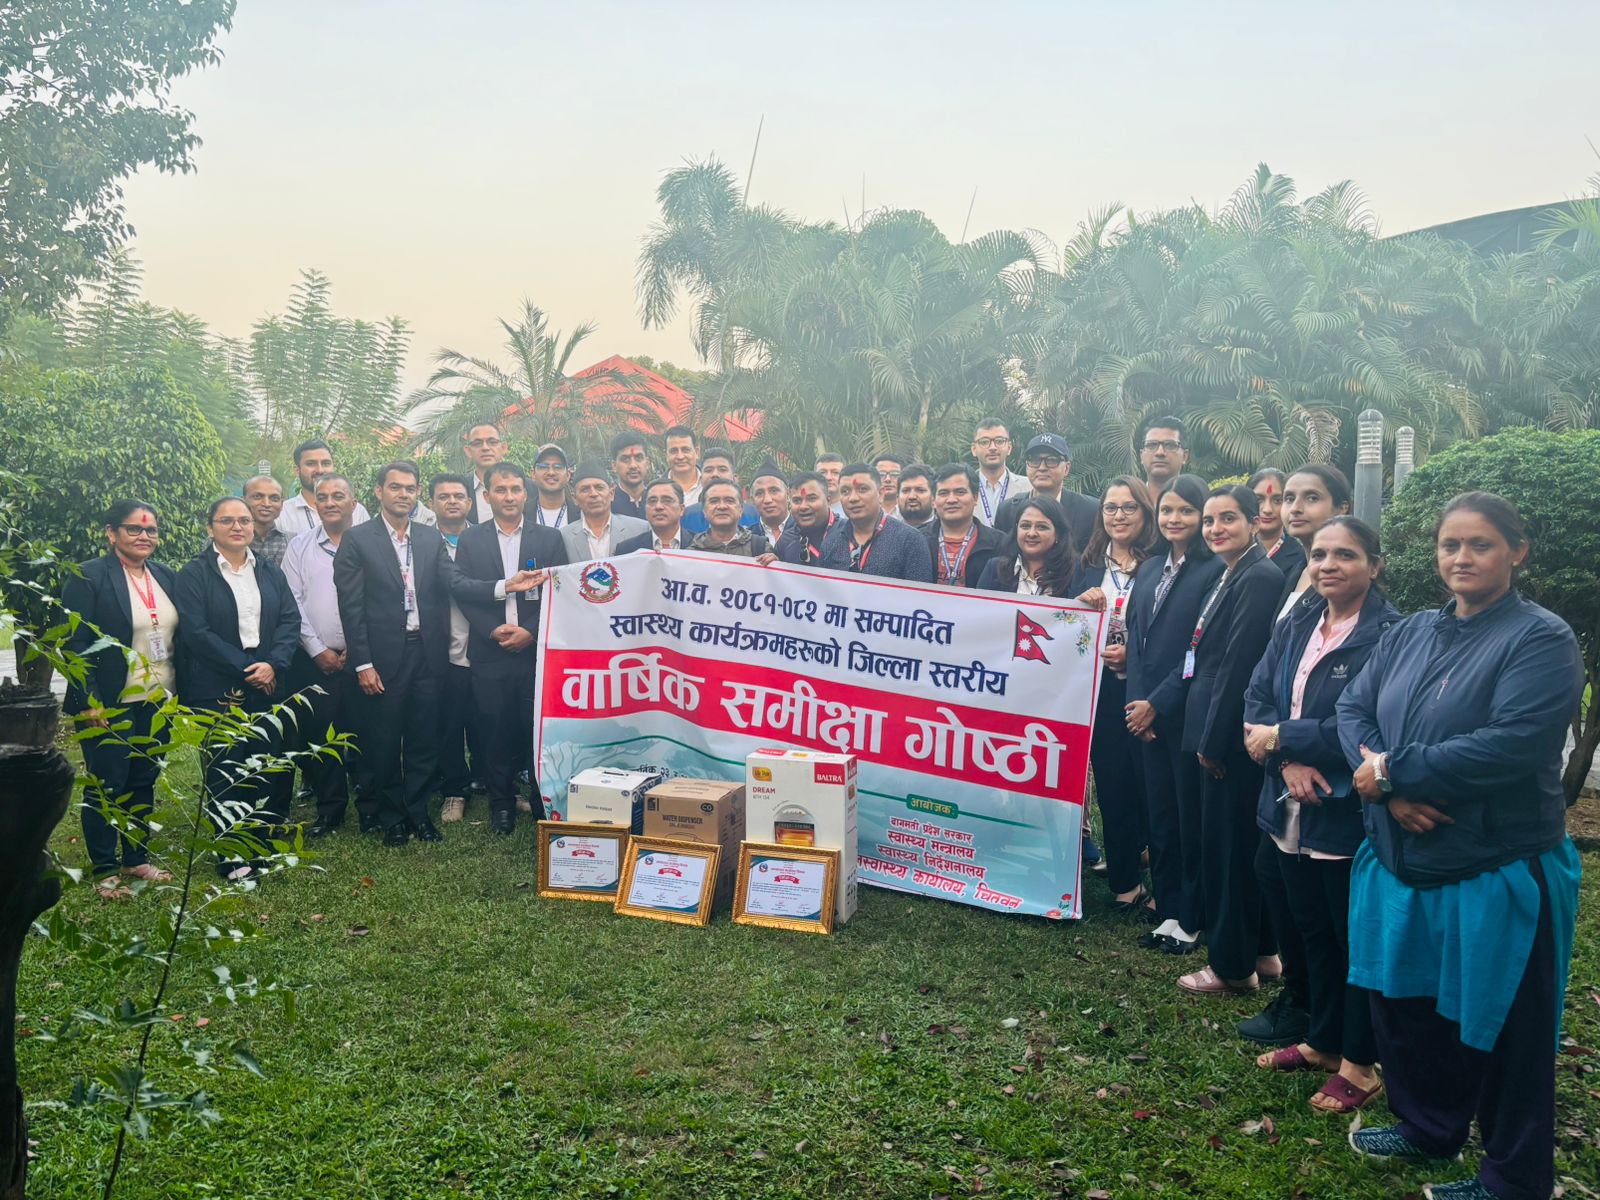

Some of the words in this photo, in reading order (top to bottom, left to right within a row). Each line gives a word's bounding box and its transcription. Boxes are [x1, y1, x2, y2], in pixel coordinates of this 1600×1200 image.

[661, 577, 711, 605] आ.व.
[720, 587, 818, 622] २०८१-०८२
[824, 603, 849, 628] मा
[854, 608, 955, 645] सम्पादित
[609, 613, 683, 639] स्वास्थ्य
[848, 640, 922, 681] जिल्ला
[929, 660, 1009, 696] स्तरीय
[562, 652, 705, 711] वार्षिक
[720, 679, 888, 754] समीक्षा
[904, 706, 1067, 789] गोष्ठी
[752, 786, 776, 794] DREAM
[816, 773, 842, 783] BALTRA
[887, 830, 926, 849] स्वास्थ्य
[930, 840, 975, 860] मन्त्रालय
[944, 828, 974, 843] सरकार
[878, 844, 918, 863] स्वास्थ्य
[975, 882, 1023, 909] चितवन
